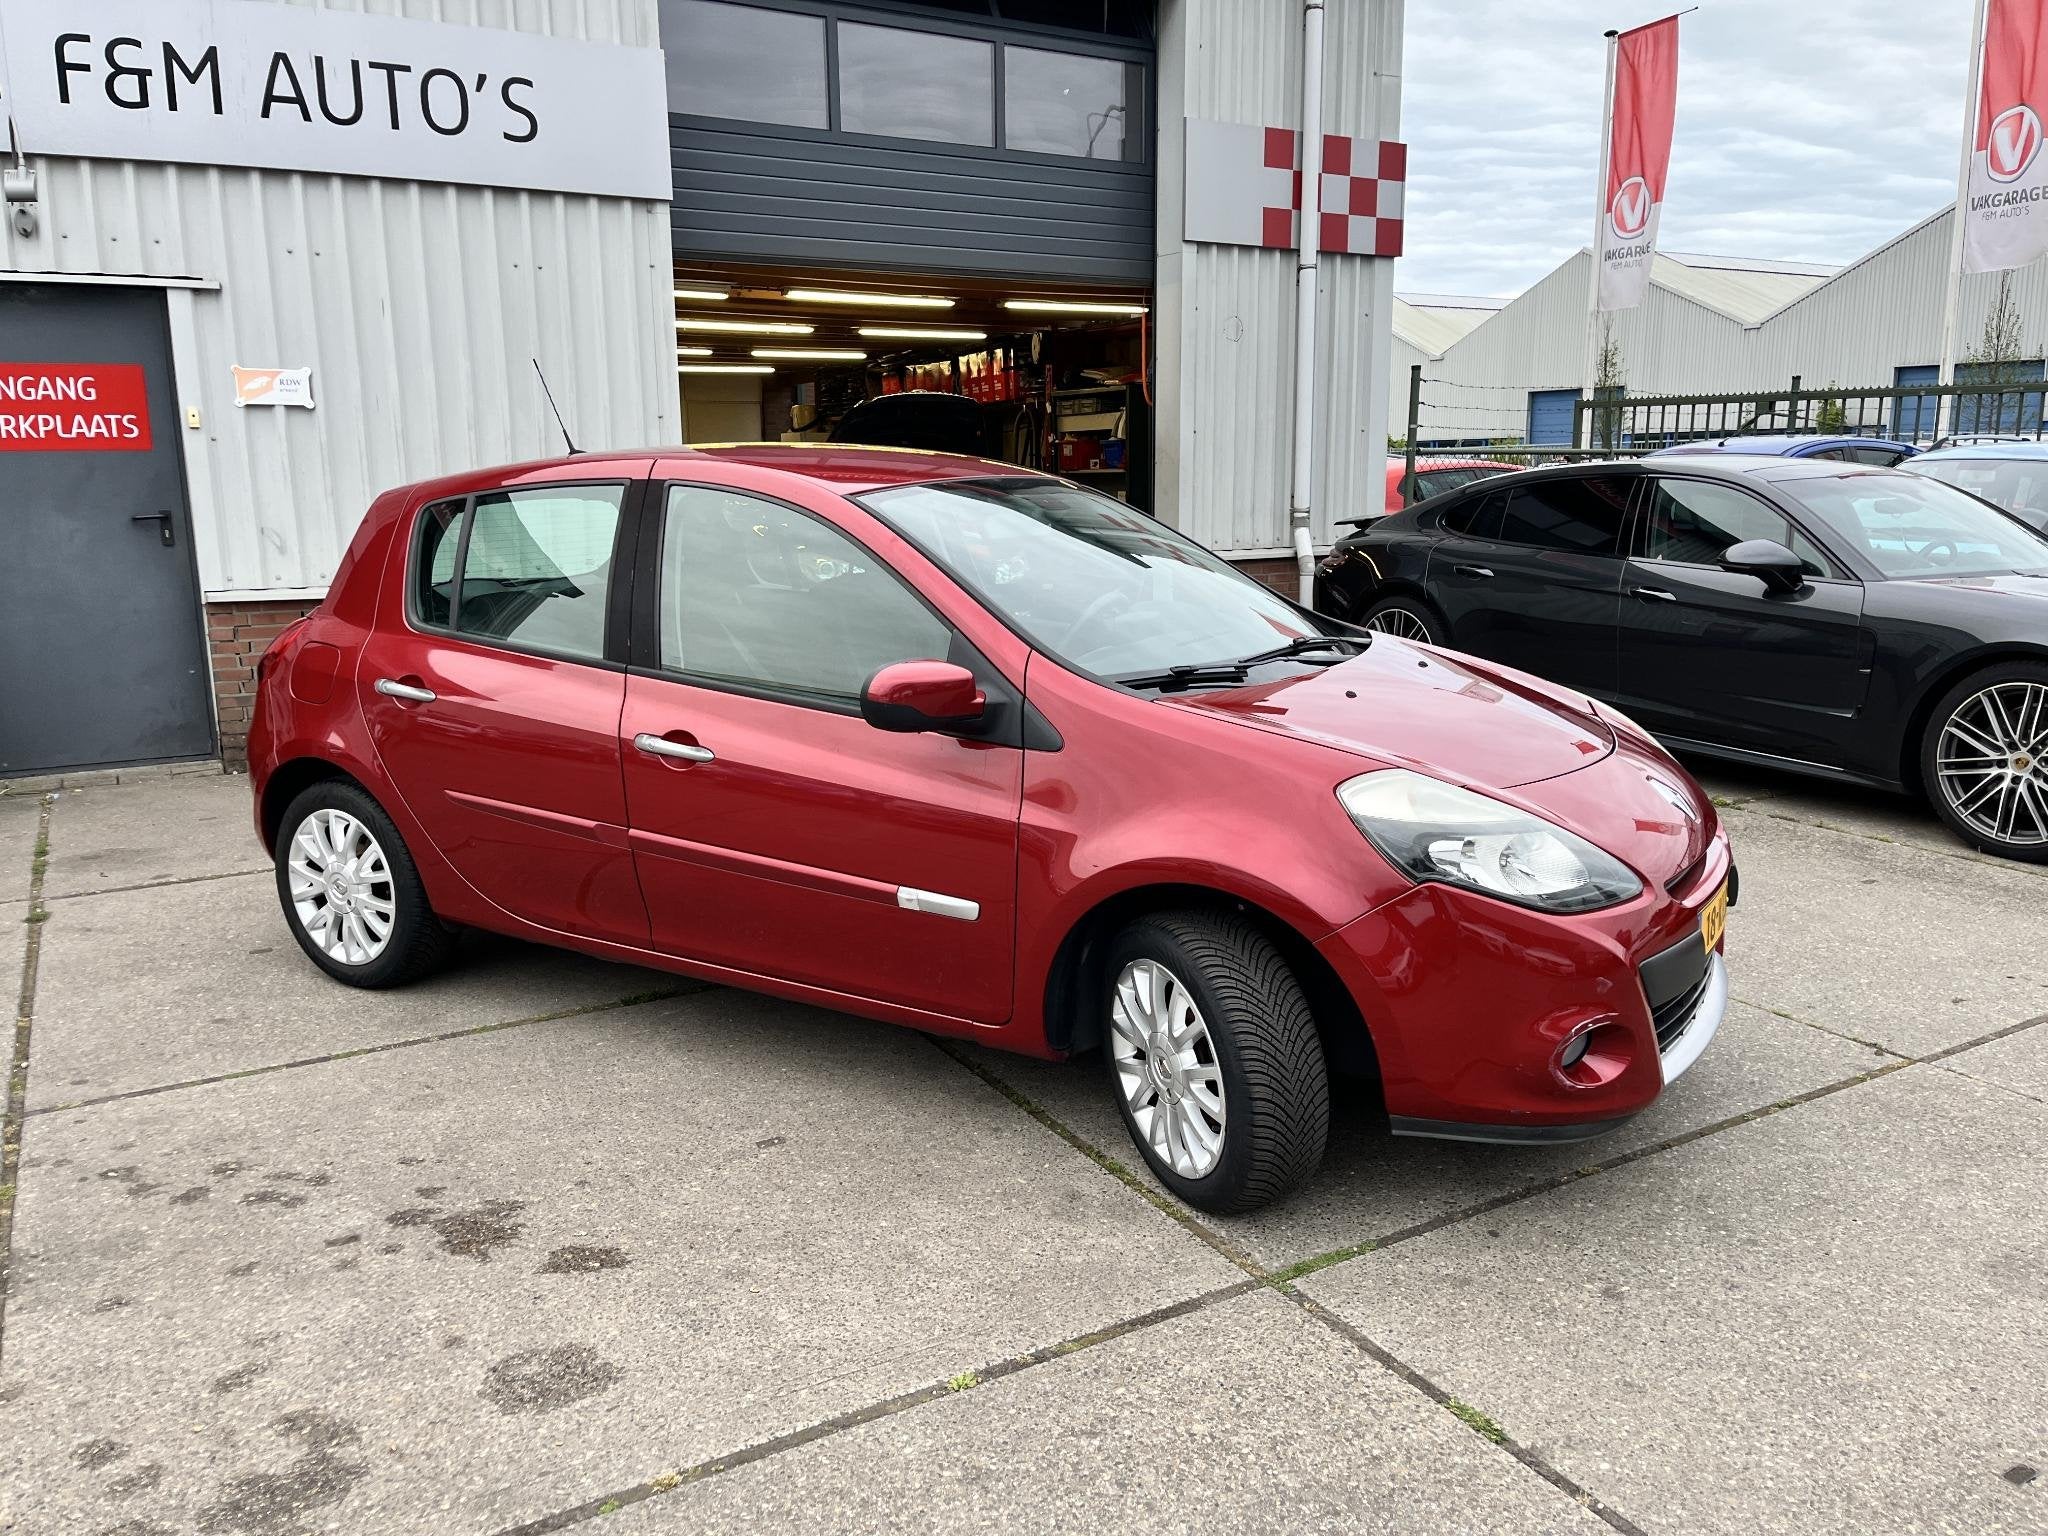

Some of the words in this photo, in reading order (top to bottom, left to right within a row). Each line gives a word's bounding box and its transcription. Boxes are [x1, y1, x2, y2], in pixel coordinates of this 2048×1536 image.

[54, 33, 223, 116] F&M
[260, 51, 539, 143] AUTO'S
[1971, 185, 2048, 211] VAKGARAGE
[279, 378, 302, 386] RDW
